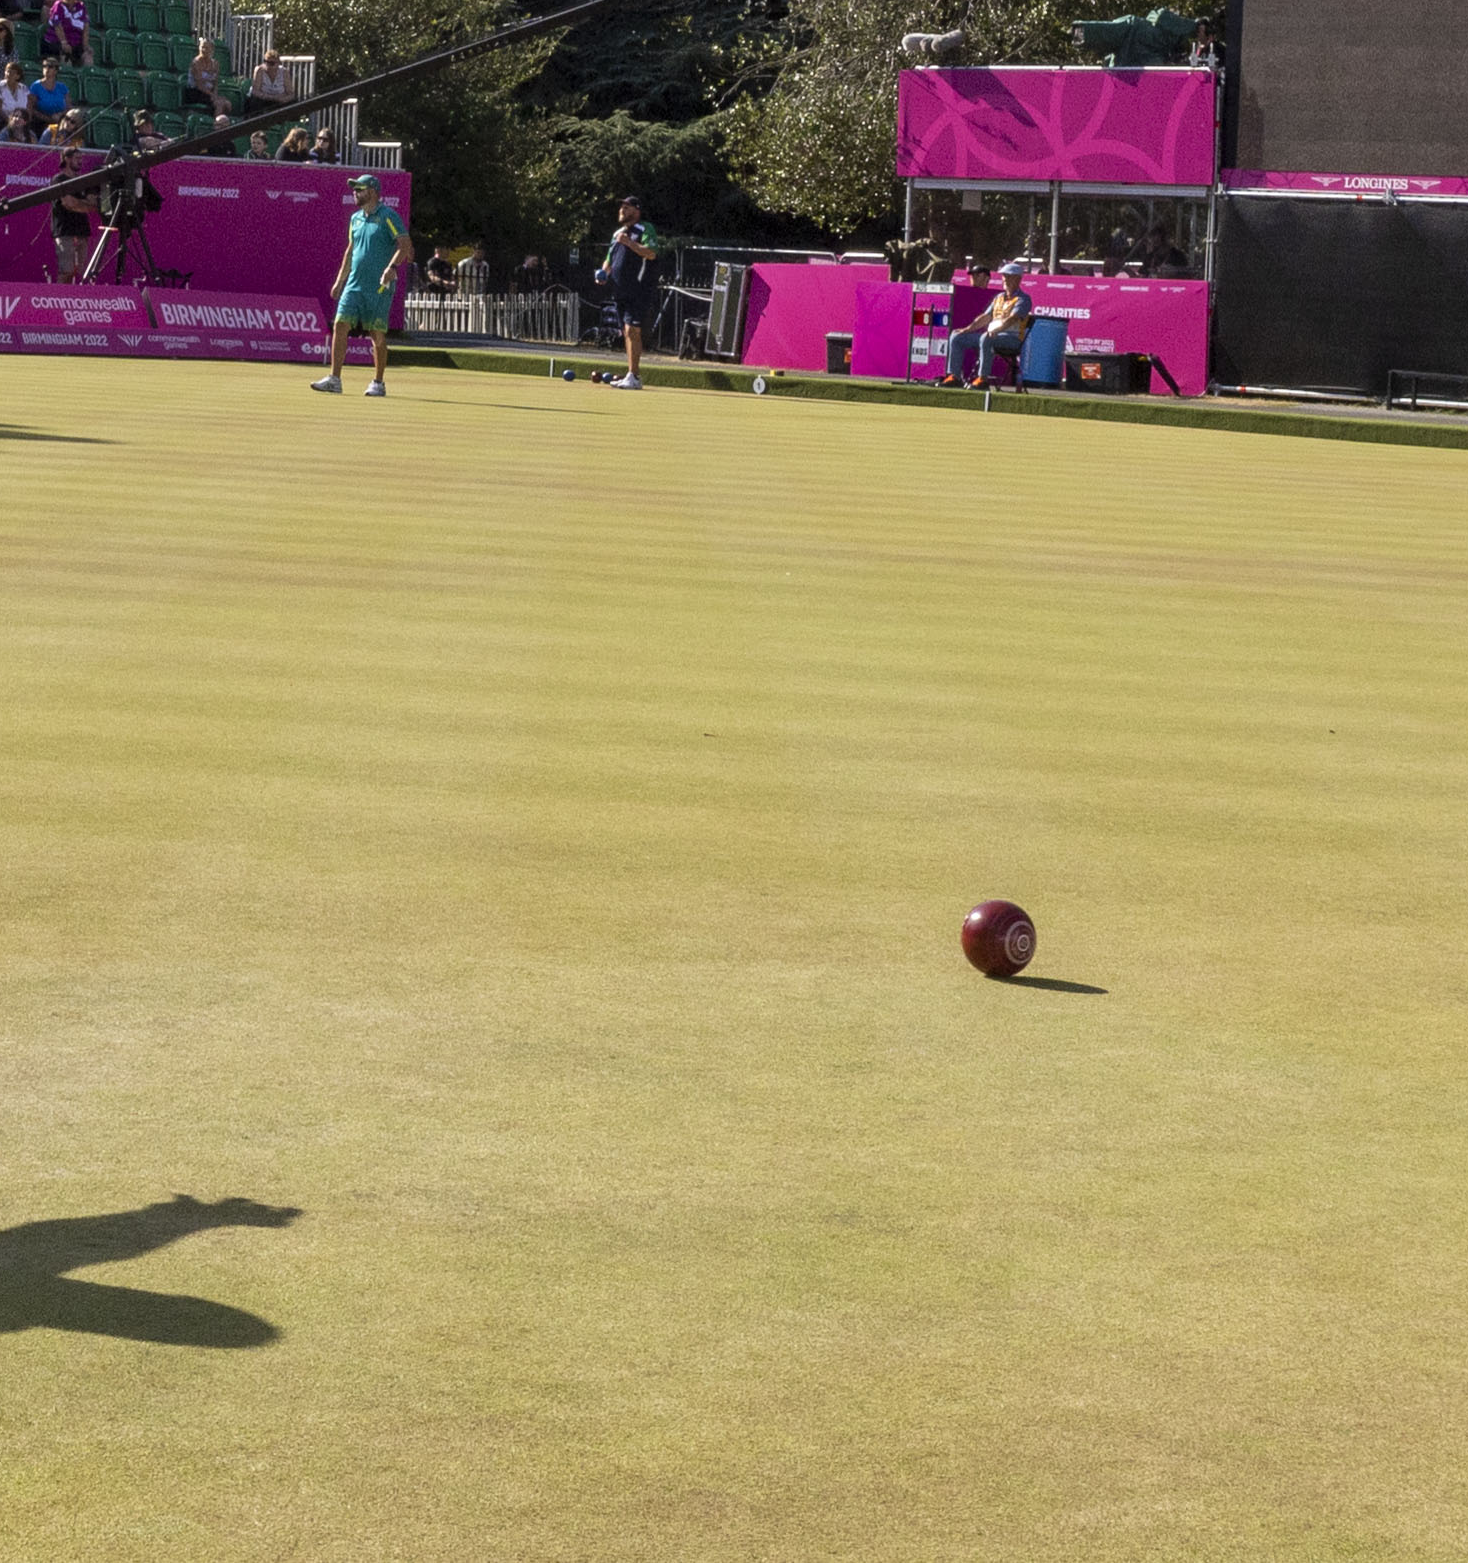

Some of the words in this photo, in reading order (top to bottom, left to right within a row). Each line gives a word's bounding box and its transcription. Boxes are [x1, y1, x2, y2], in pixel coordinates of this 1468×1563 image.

[1344, 176, 1408, 190] LONGINES
[178, 185, 221, 198] BIRMINGHAM
[222, 187, 240, 199] 2022
[31, 295, 136, 312] commonwealth
[64, 309, 113, 326] games
[159, 303, 272, 331] BIRMINGHAM
[274, 309, 321, 333] 2022
[1034, 306, 1091, 320] CHARITIES
[22, 332, 83, 347] BIRMINGHAM
[84, 335, 109, 347] 2022
[939, 342, 946, 355] 4
